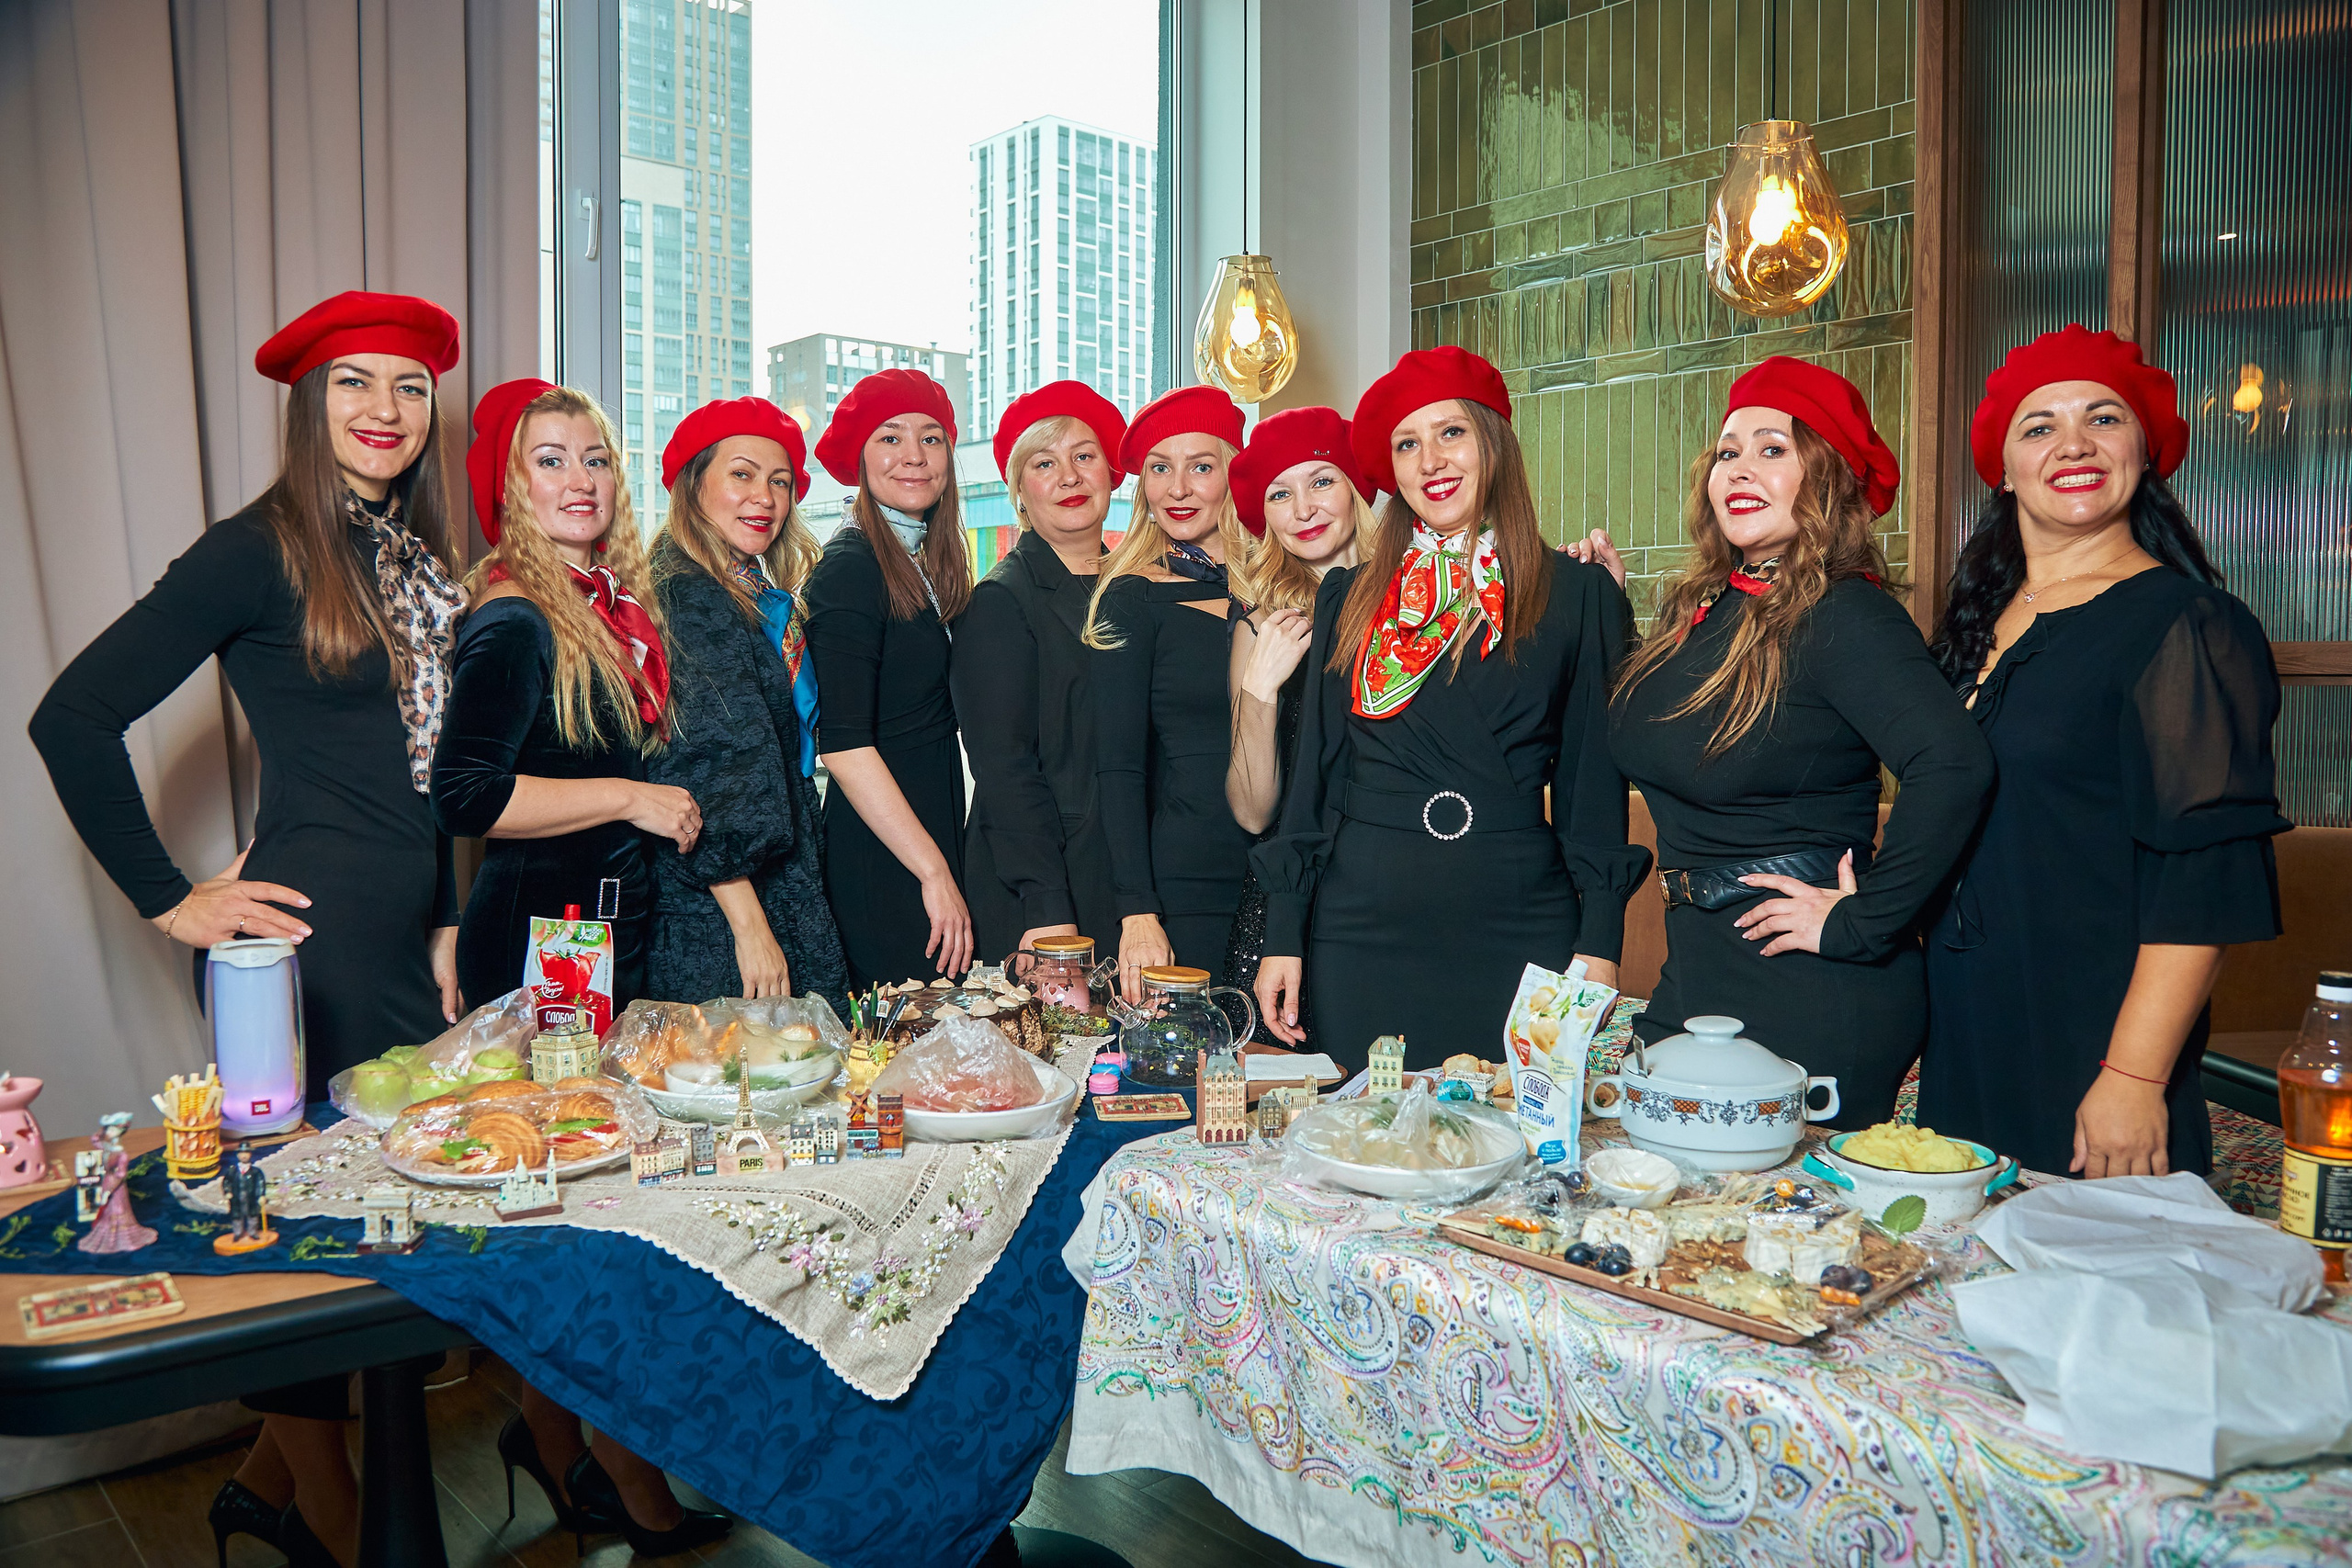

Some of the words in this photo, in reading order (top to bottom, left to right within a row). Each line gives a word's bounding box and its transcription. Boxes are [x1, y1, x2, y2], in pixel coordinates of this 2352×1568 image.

[545, 1010, 575, 1023] СЛОБОД
[1523, 1076, 1550, 1100] СЛОБОДА
[1519, 1104, 1555, 1128] МЕТАННЫЙ
[740, 1157, 763, 1168] PARIS
